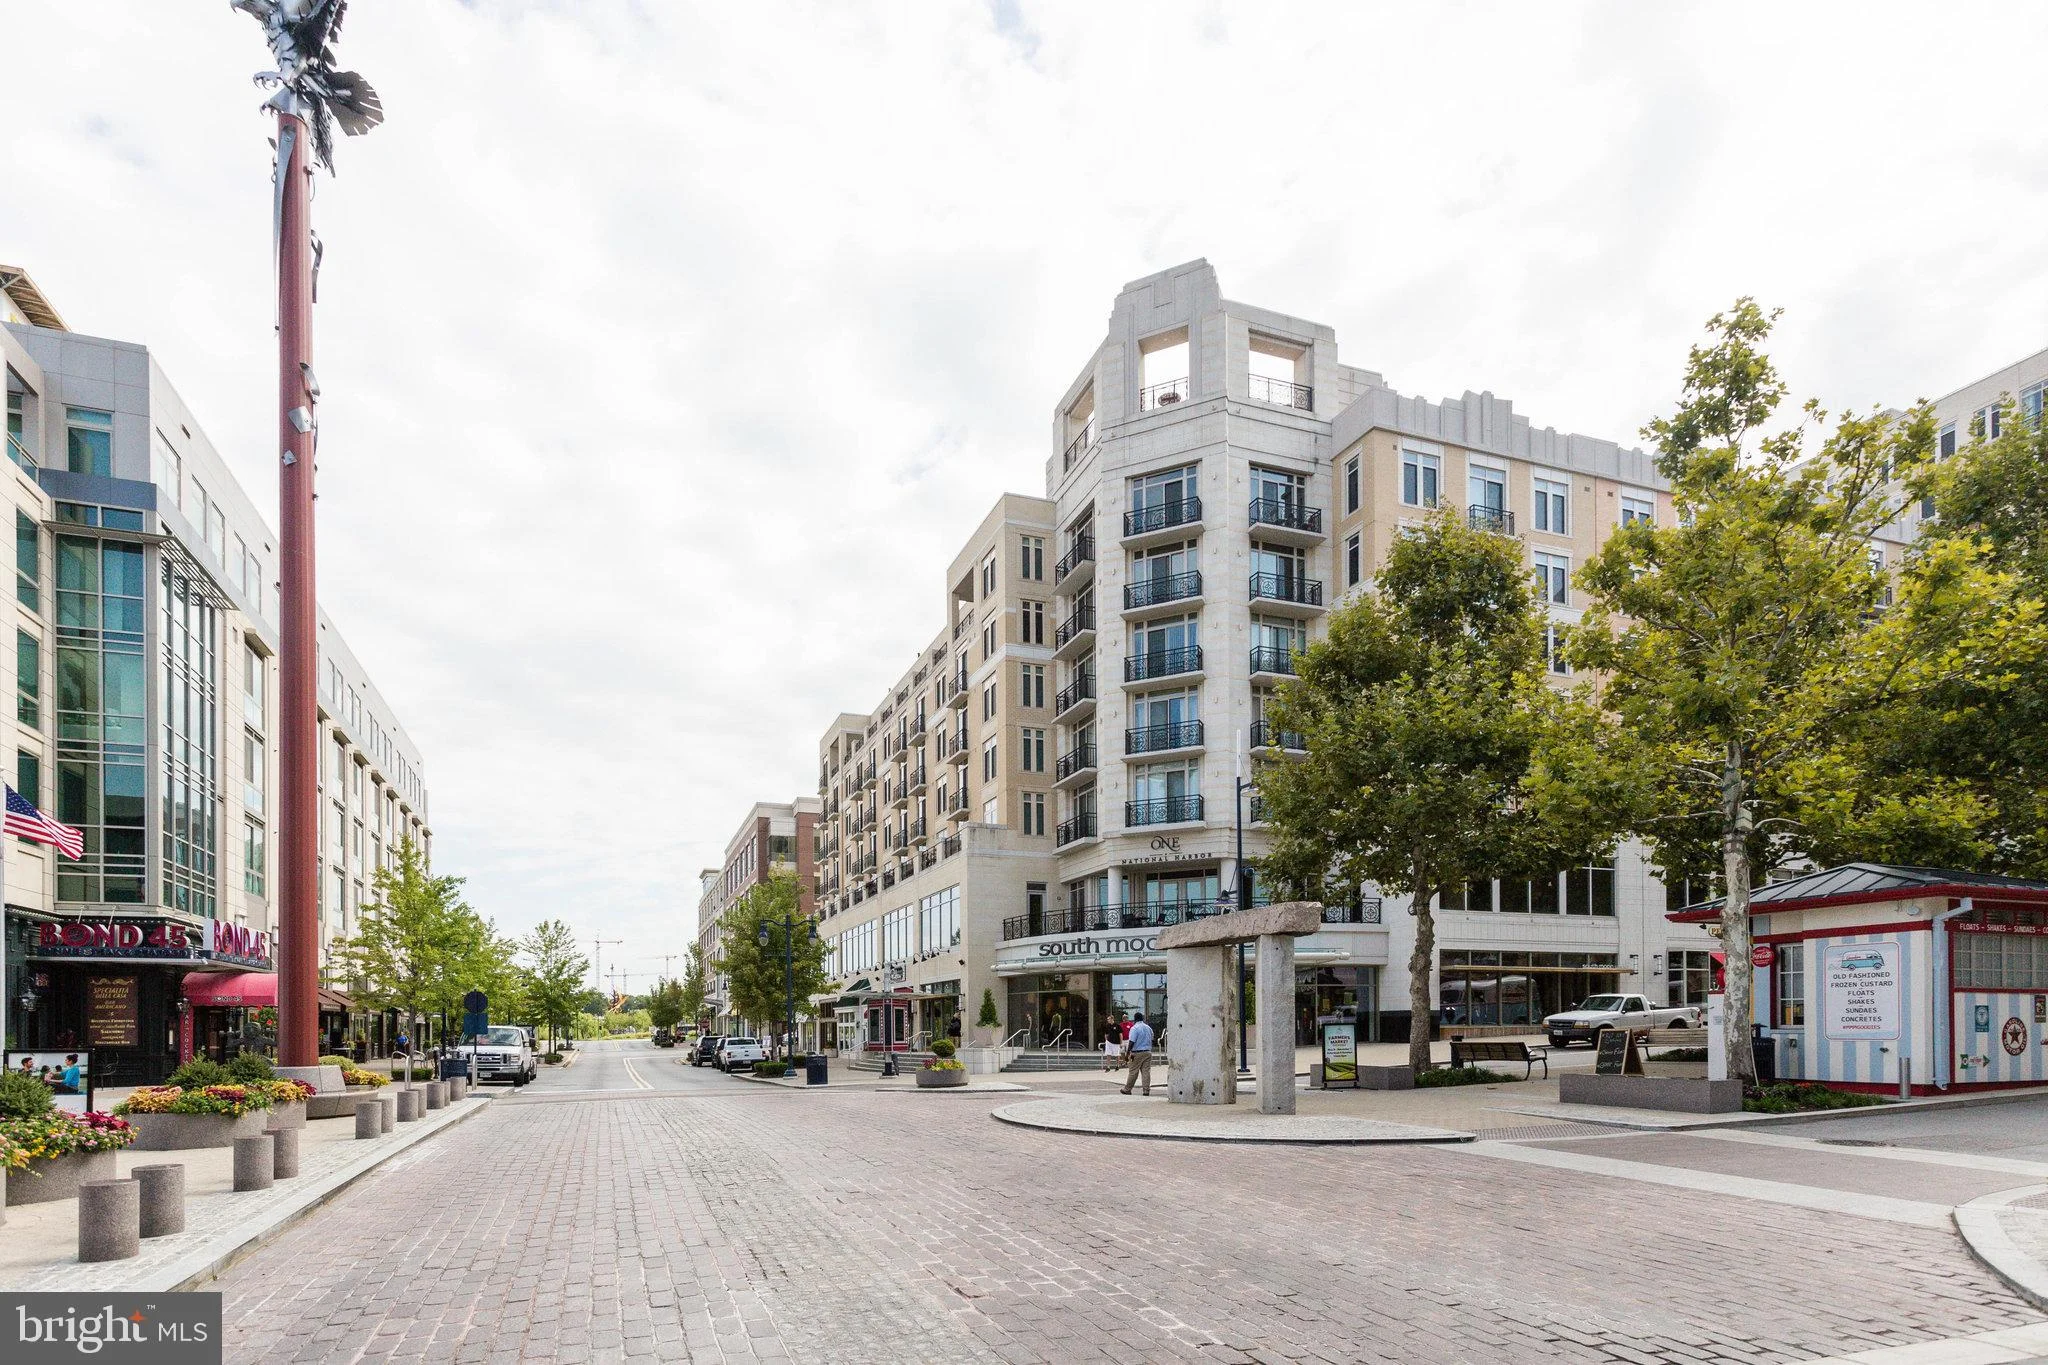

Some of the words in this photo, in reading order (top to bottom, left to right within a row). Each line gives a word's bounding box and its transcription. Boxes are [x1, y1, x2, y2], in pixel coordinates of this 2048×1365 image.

[1150, 835, 1181, 852] ONE
[1121, 856, 1168, 865] NATIONAL
[1174, 852, 1213, 861] HARBOR
[40, 922, 142, 948] BOND
[149, 923, 191, 949] 45
[1959, 923, 1980, 931] FLOATS
[1986, 924, 2006, 932] SHAKES
[2013, 925, 2036, 934] SUNDAES
[213, 919, 250, 958] BOND
[252, 931, 266, 960] 45
[1039, 937, 1099, 957] south
[1106, 938, 1158, 953] moo
[1848, 971, 1891, 979] FASHIONED
